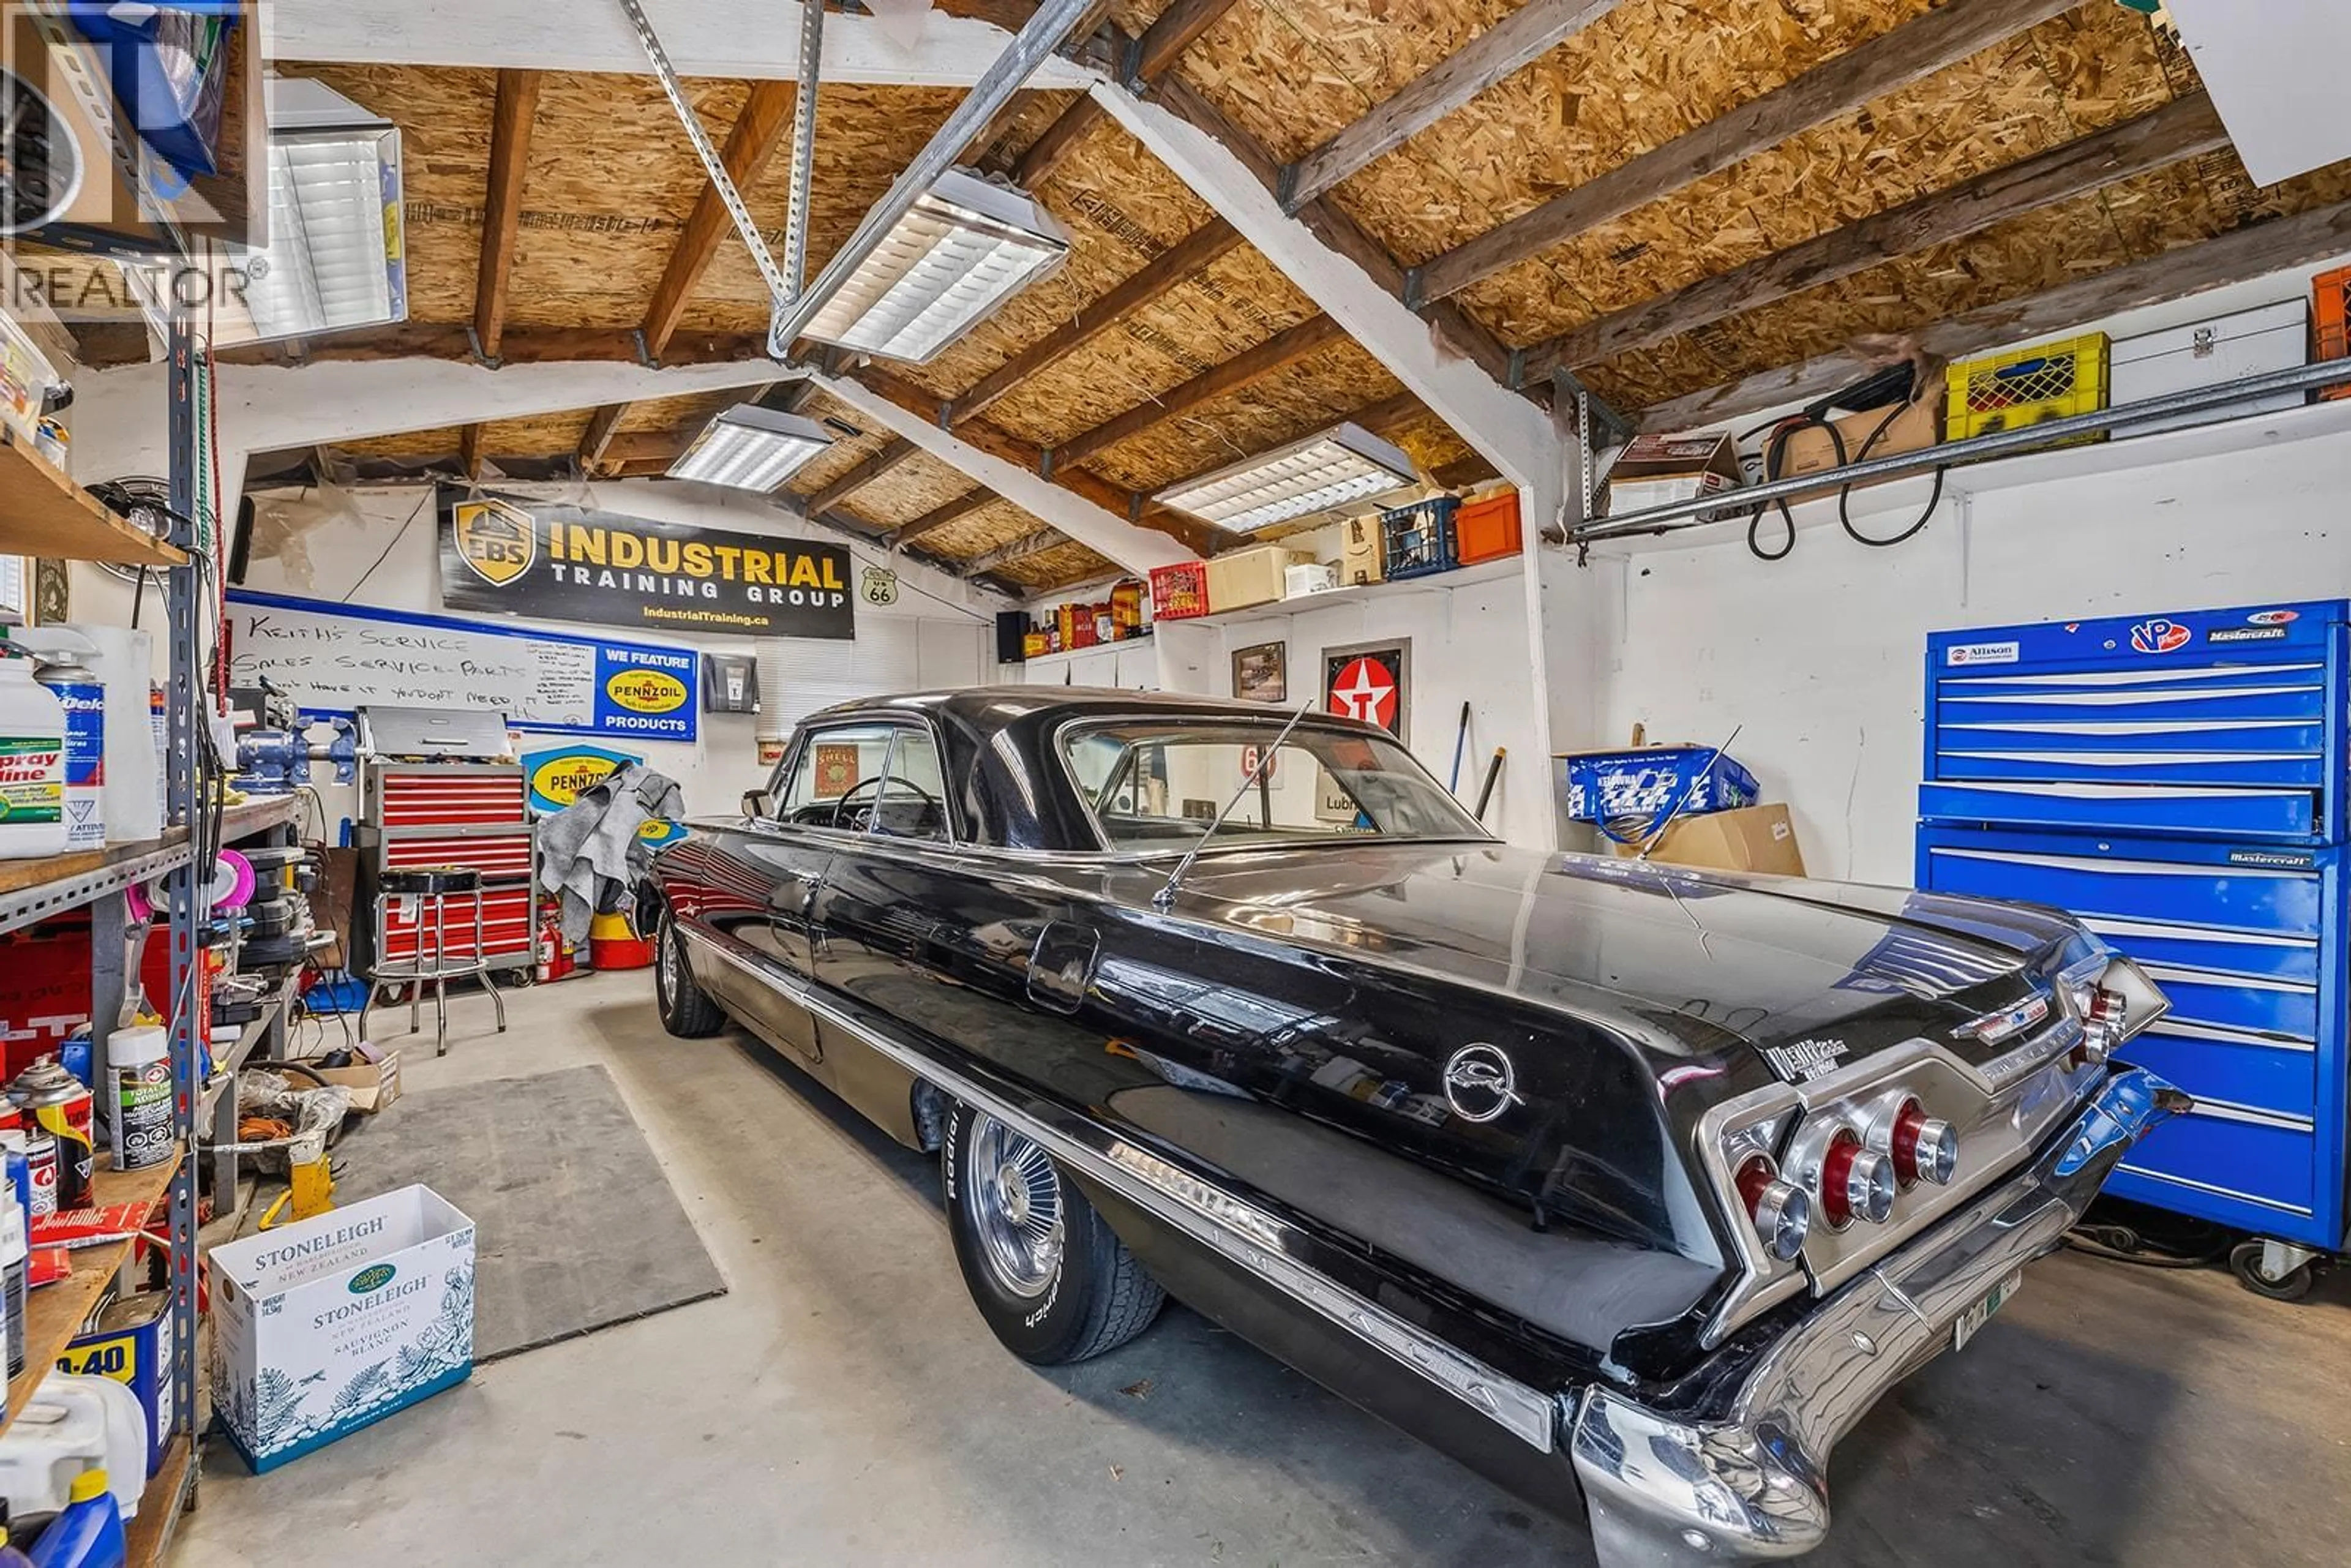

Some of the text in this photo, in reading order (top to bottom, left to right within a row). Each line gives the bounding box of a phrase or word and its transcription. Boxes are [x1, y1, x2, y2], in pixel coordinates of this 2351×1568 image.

[468, 538, 525, 565] EBS
[550, 522, 843, 590] INDUSTRIAL
[552, 563, 844, 608] TRAINING GROUP
[869, 587, 890, 602] 66
[643, 606, 769, 626] IndustrialTraining.ca
[605, 648, 690, 669] WE FEATURE
[1970, 647, 2012, 656] Allison
[614, 686, 681, 697] PENNZOIL
[605, 715, 686, 732] PRODUCTS
[255, 1216, 384, 1271] STONELEIGH
[279, 1247, 367, 1283] NEW ZEALAND
[313, 1277, 427, 1330] STONELEIGH
